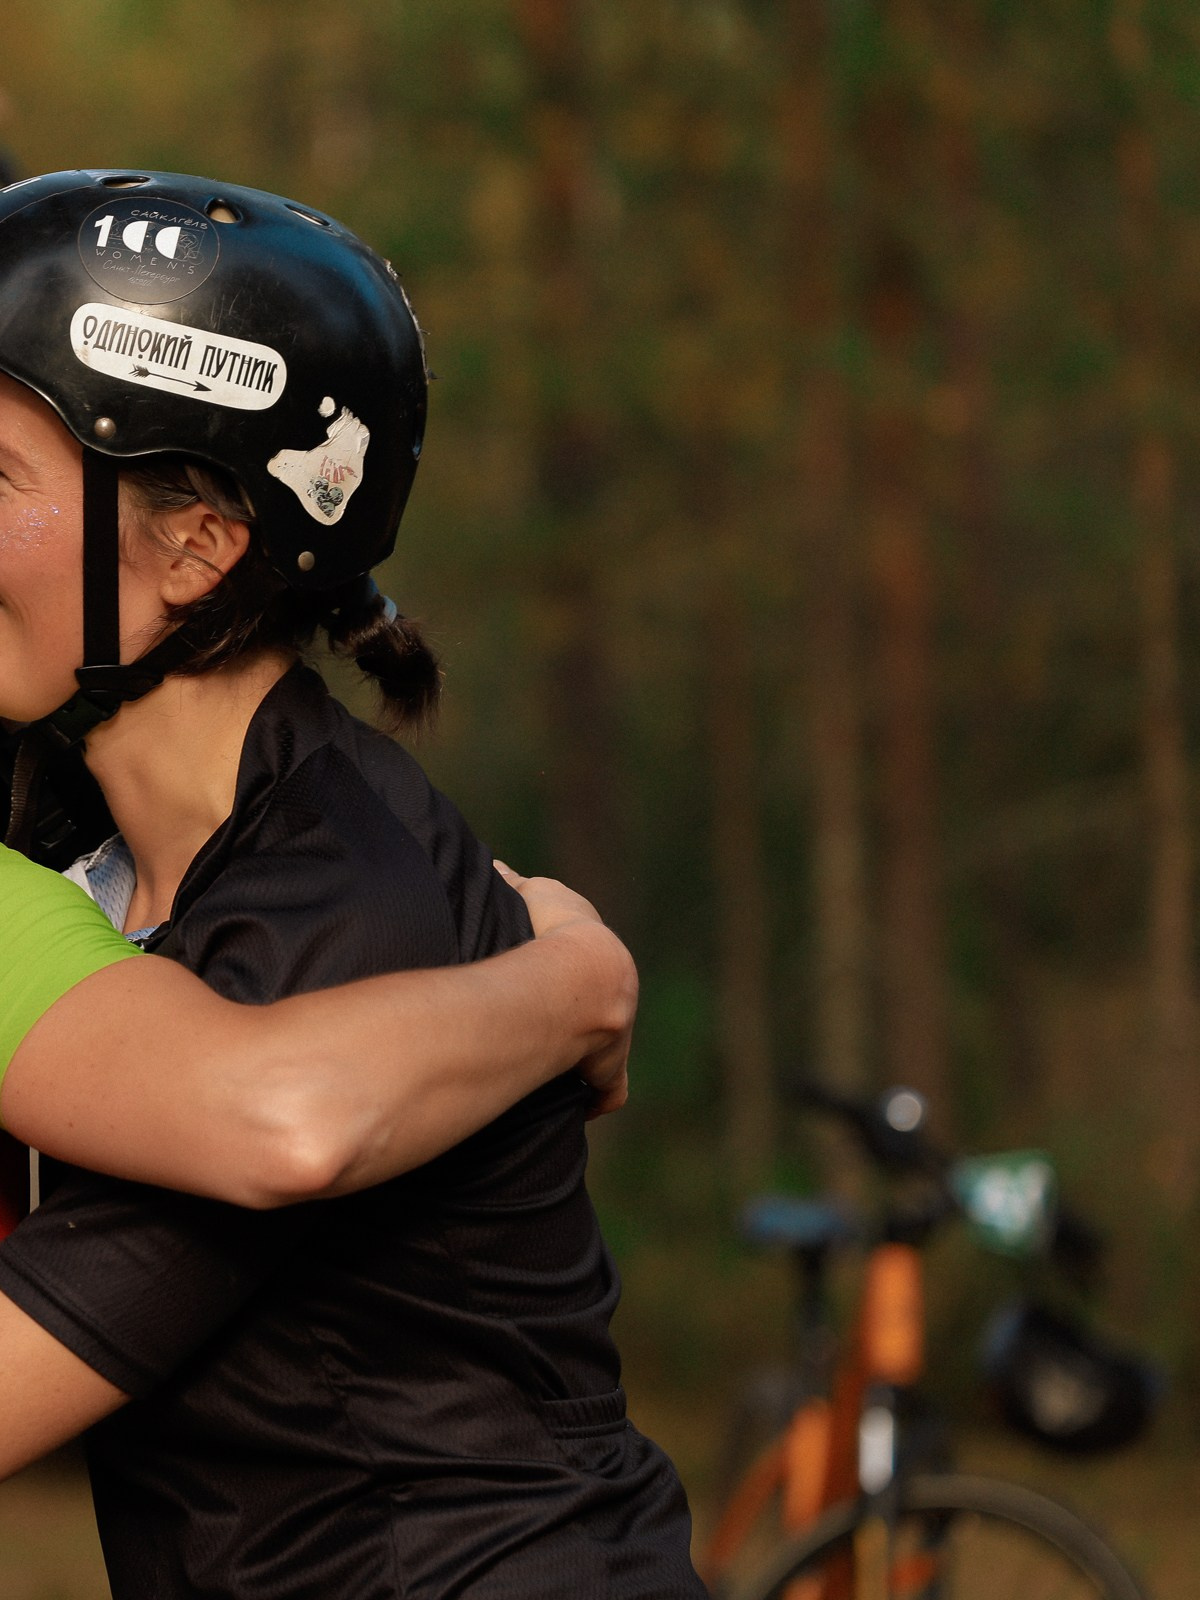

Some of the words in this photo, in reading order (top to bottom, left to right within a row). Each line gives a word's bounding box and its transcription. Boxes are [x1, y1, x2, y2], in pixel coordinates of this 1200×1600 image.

[95, 248, 195, 275] WOMEN'S
[82, 315, 193, 371] ОДИНОКИЙ
[198, 344, 278, 393] ПУТНИК
